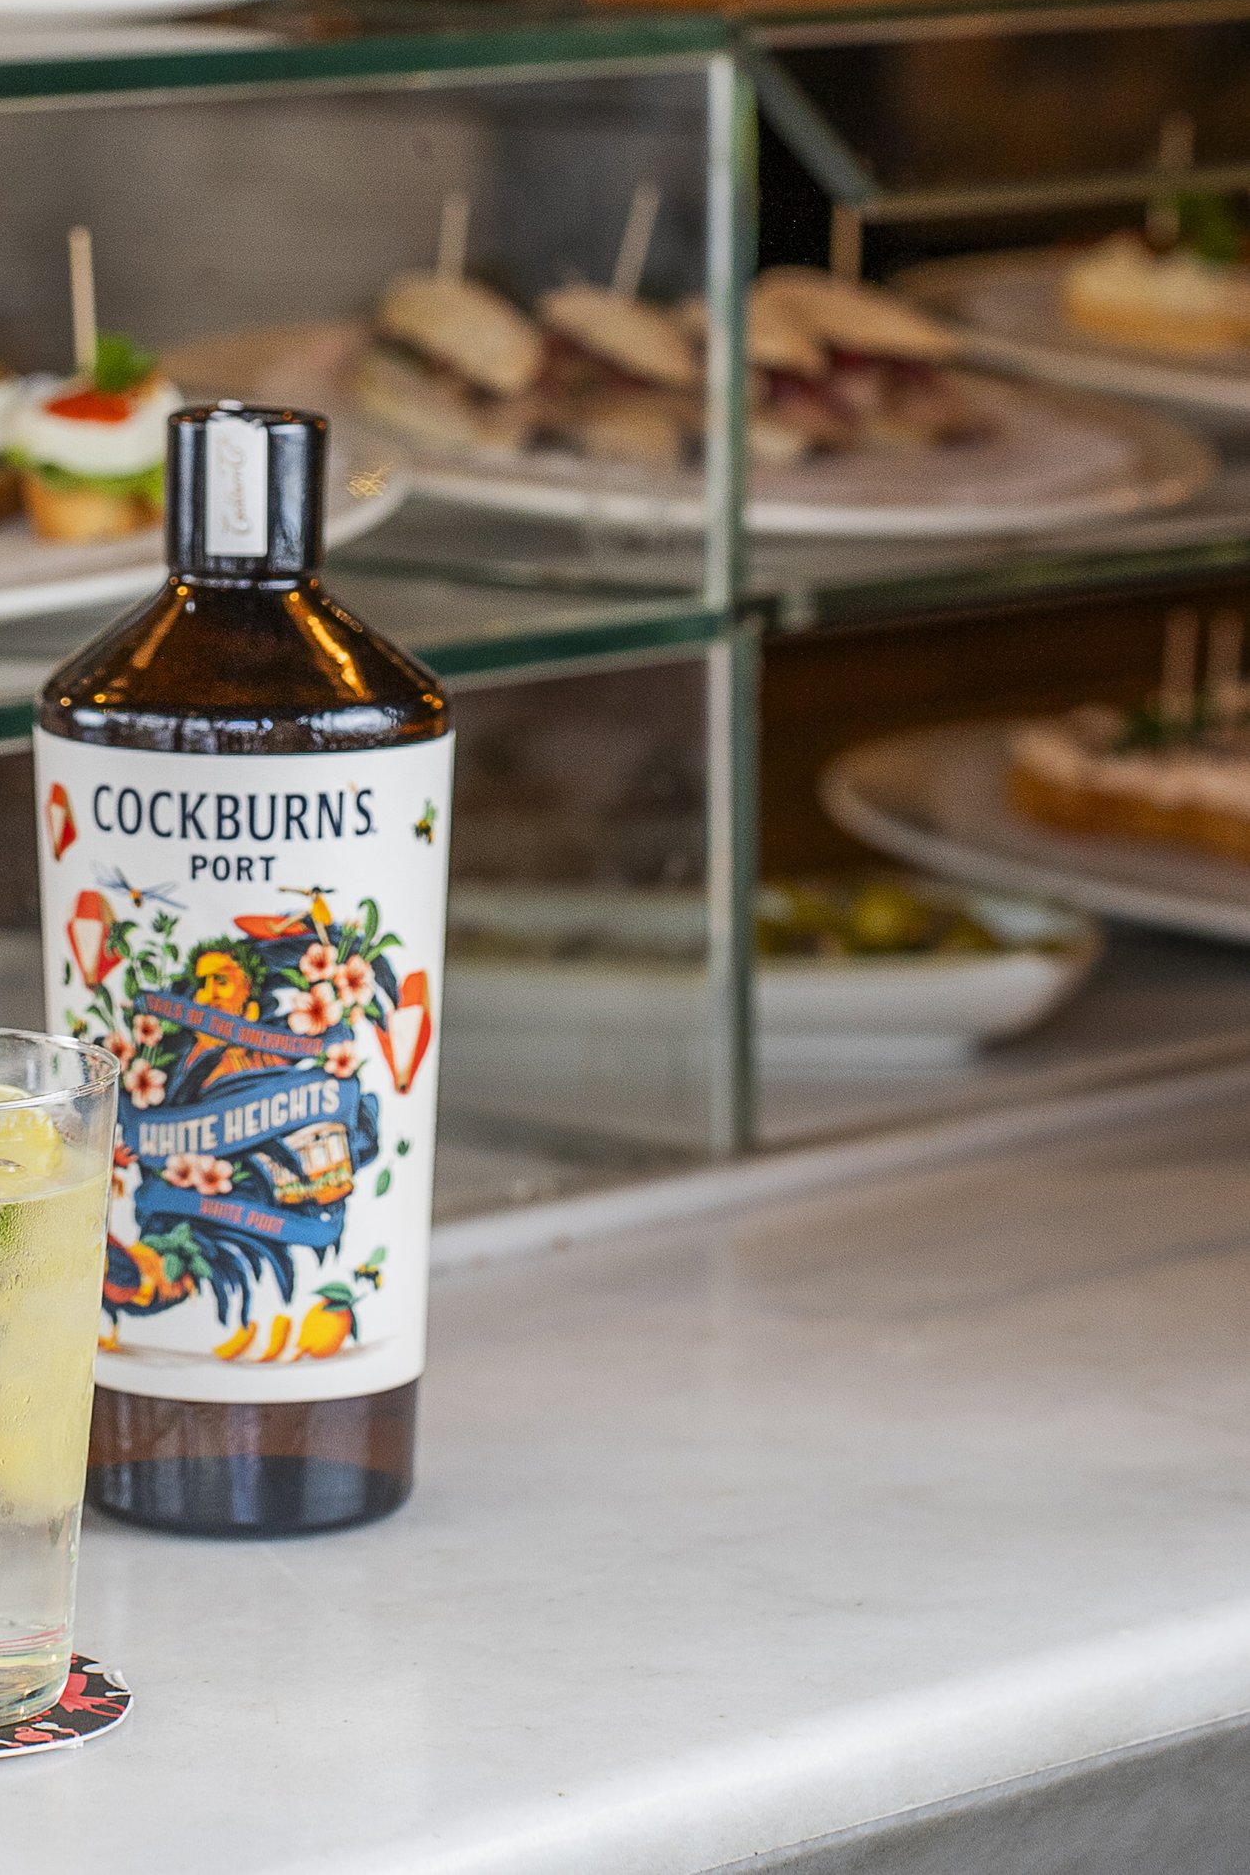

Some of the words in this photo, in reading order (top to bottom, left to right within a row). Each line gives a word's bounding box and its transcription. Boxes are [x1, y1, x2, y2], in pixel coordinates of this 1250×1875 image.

[191, 854, 276, 882] PORT
[138, 1114, 219, 1157] WHITE
[223, 1078, 340, 1144] HEIGHTS
